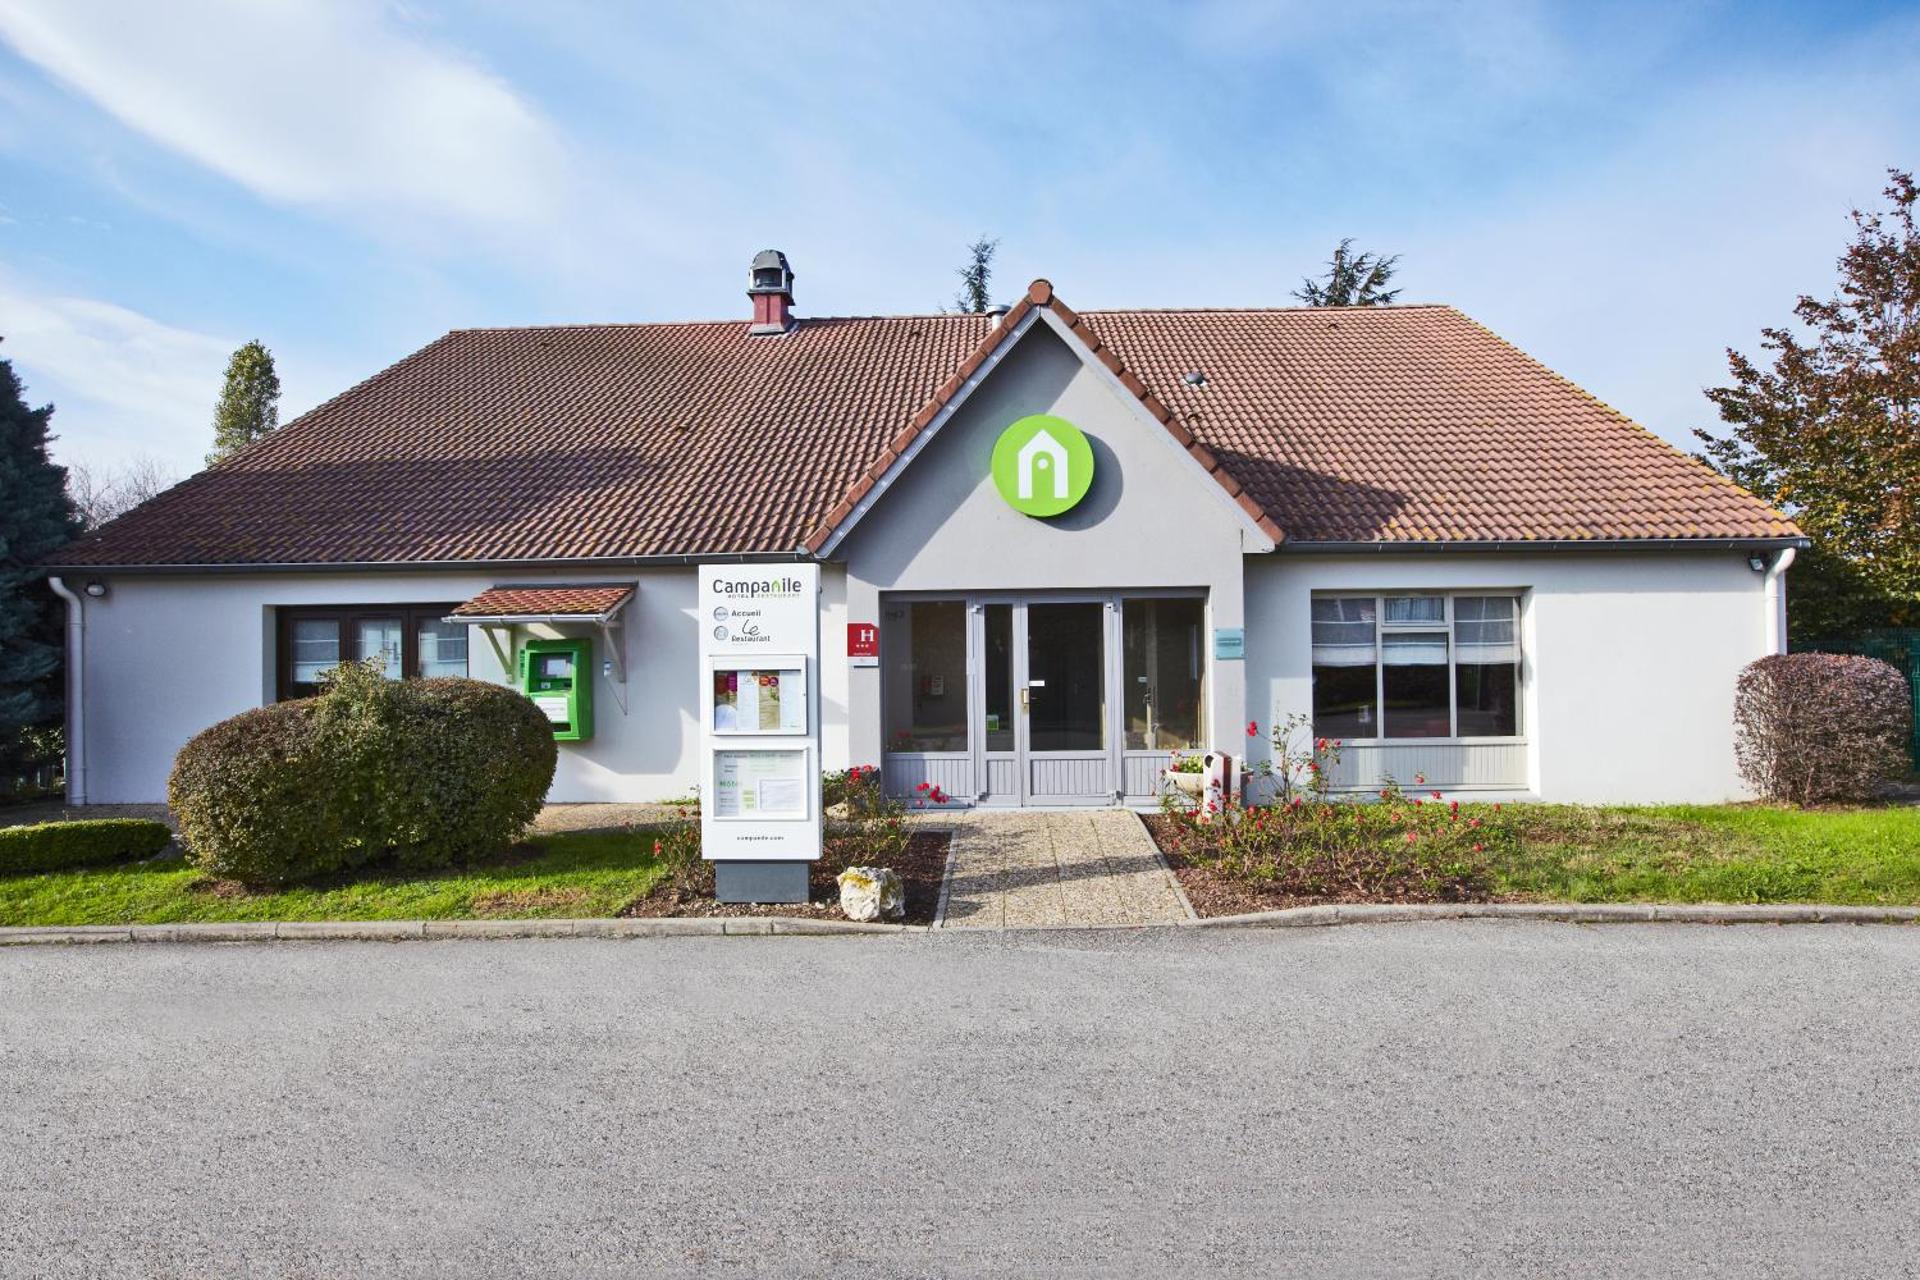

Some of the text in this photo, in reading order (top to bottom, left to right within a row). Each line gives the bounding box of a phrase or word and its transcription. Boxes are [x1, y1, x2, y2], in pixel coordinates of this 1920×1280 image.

[713, 577, 802, 598] Campanile
[731, 609, 761, 617] Accueil
[731, 634, 770, 642] Restaurant
[860, 629, 874, 641] H
